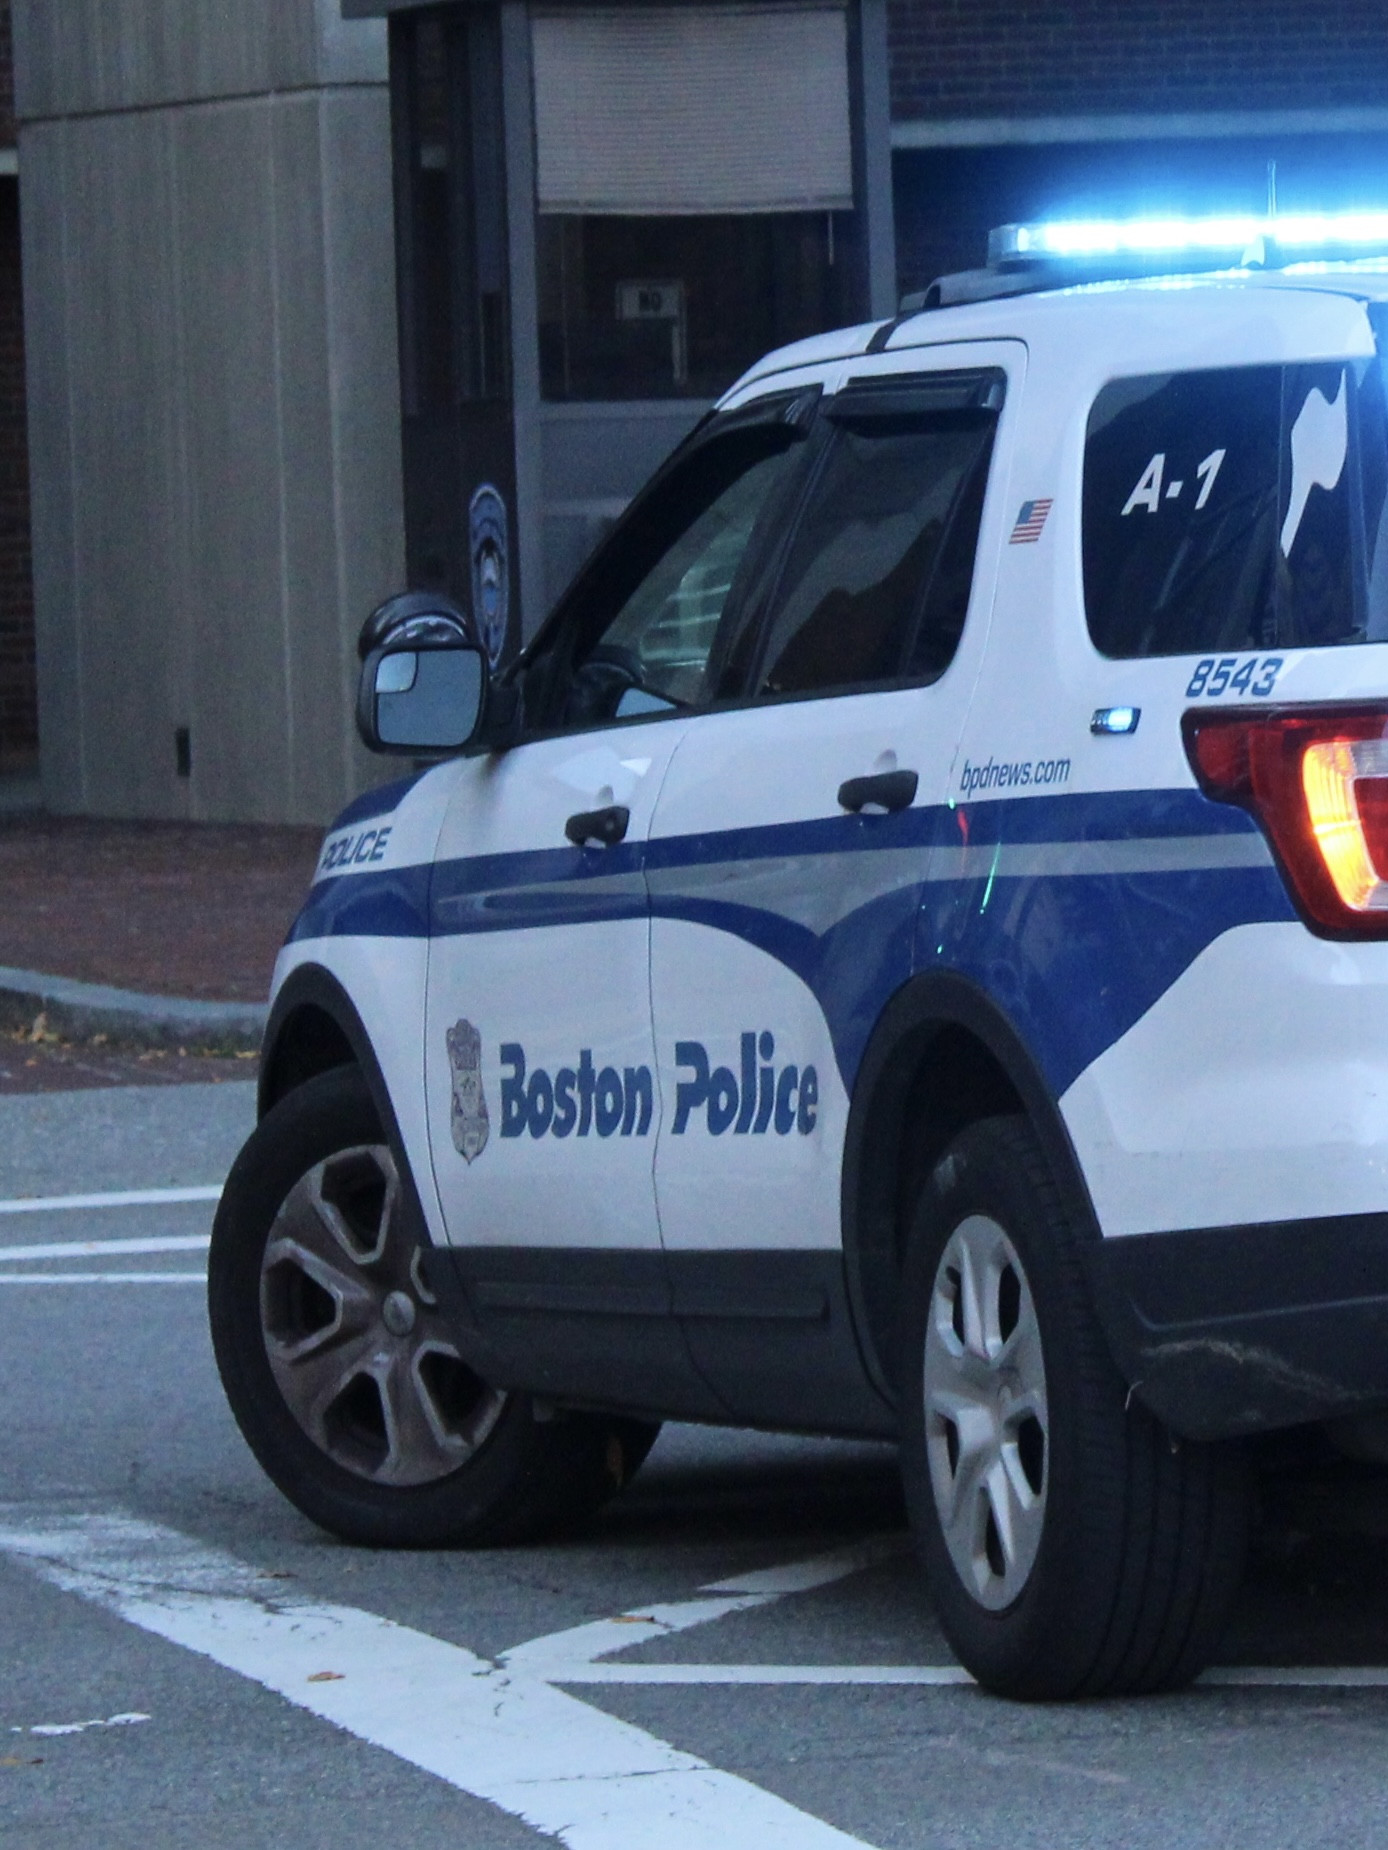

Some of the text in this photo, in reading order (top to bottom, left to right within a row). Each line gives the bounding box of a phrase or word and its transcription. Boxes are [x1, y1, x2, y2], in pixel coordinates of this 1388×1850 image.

[1120, 449, 1226, 516] A-1
[1185, 658, 1284, 698] 8543
[960, 756, 1071, 800] bpdnews.com
[321, 826, 393, 870] POLICE
[499, 1030, 819, 1139] Boston Police
